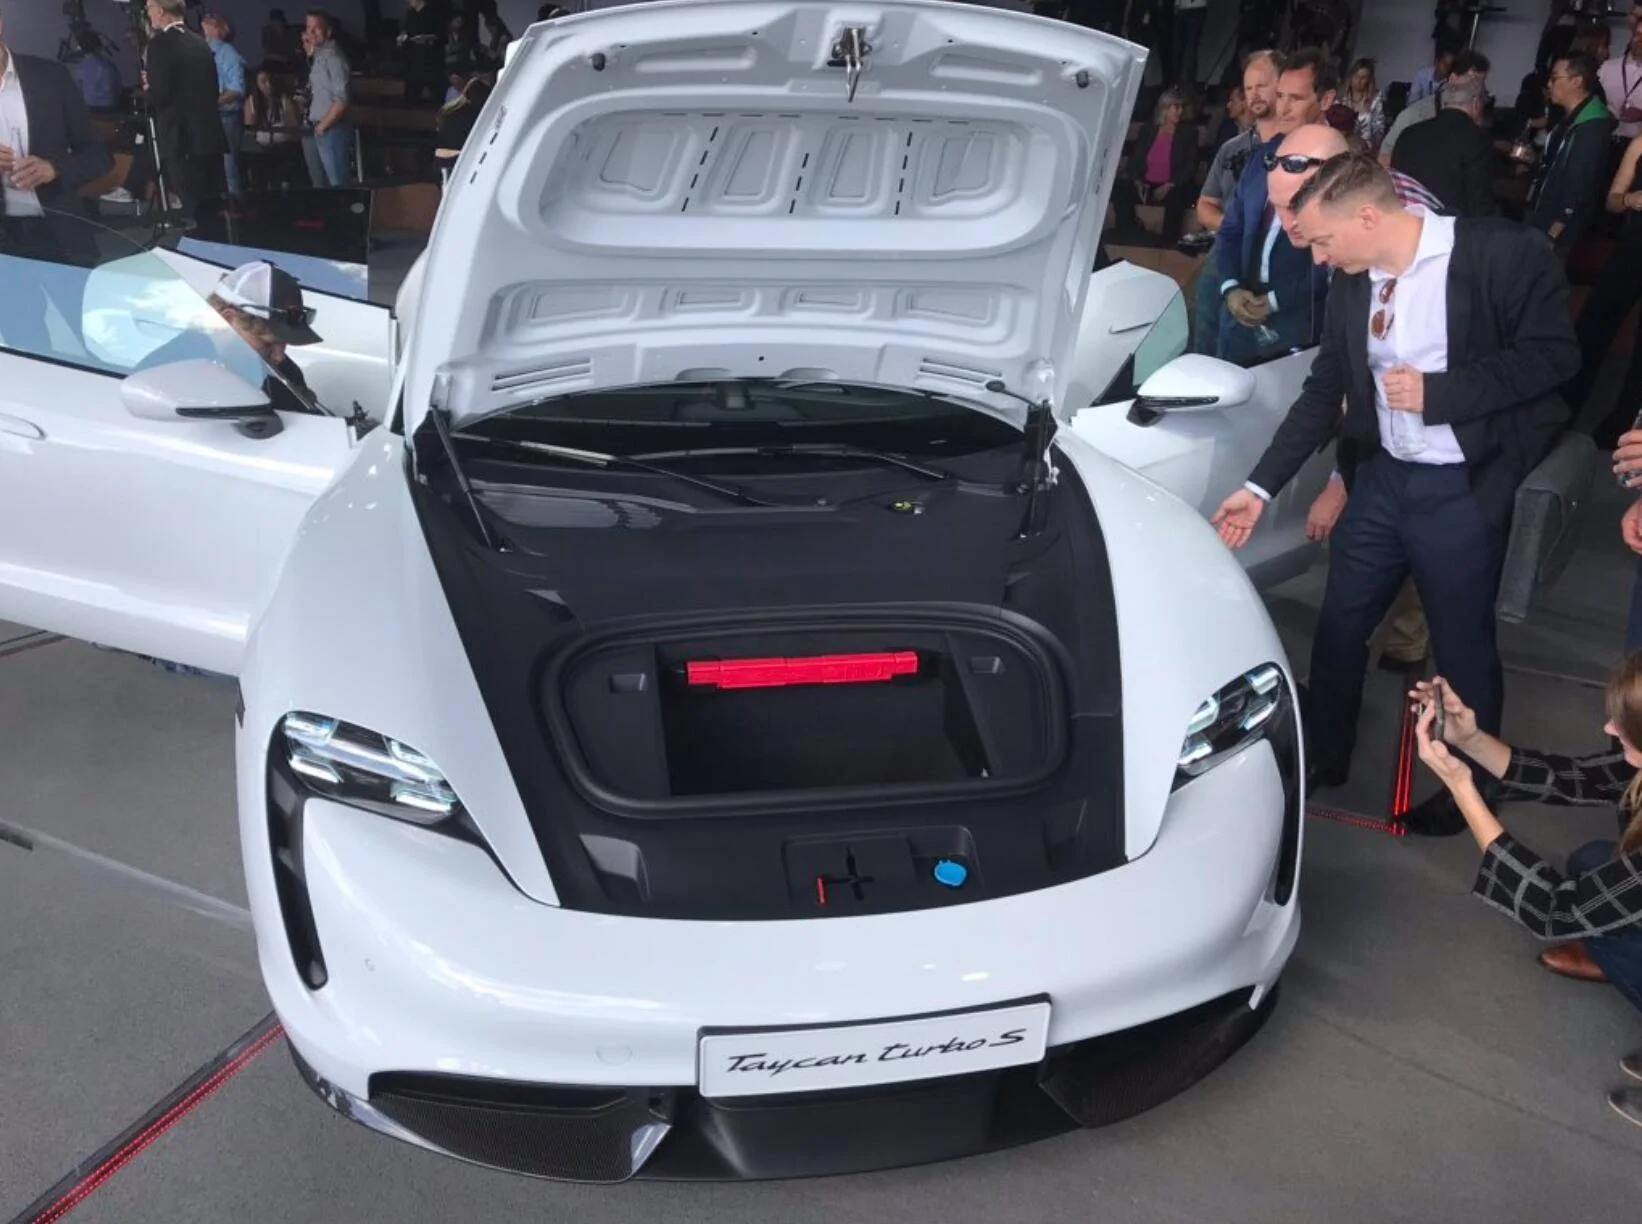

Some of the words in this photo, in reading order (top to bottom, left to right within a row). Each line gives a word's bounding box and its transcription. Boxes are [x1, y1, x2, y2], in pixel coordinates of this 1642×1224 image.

[727, 1052, 867, 1076] Taycan
[877, 1037, 986, 1062] turbo
[988, 1028, 1027, 1047] S
